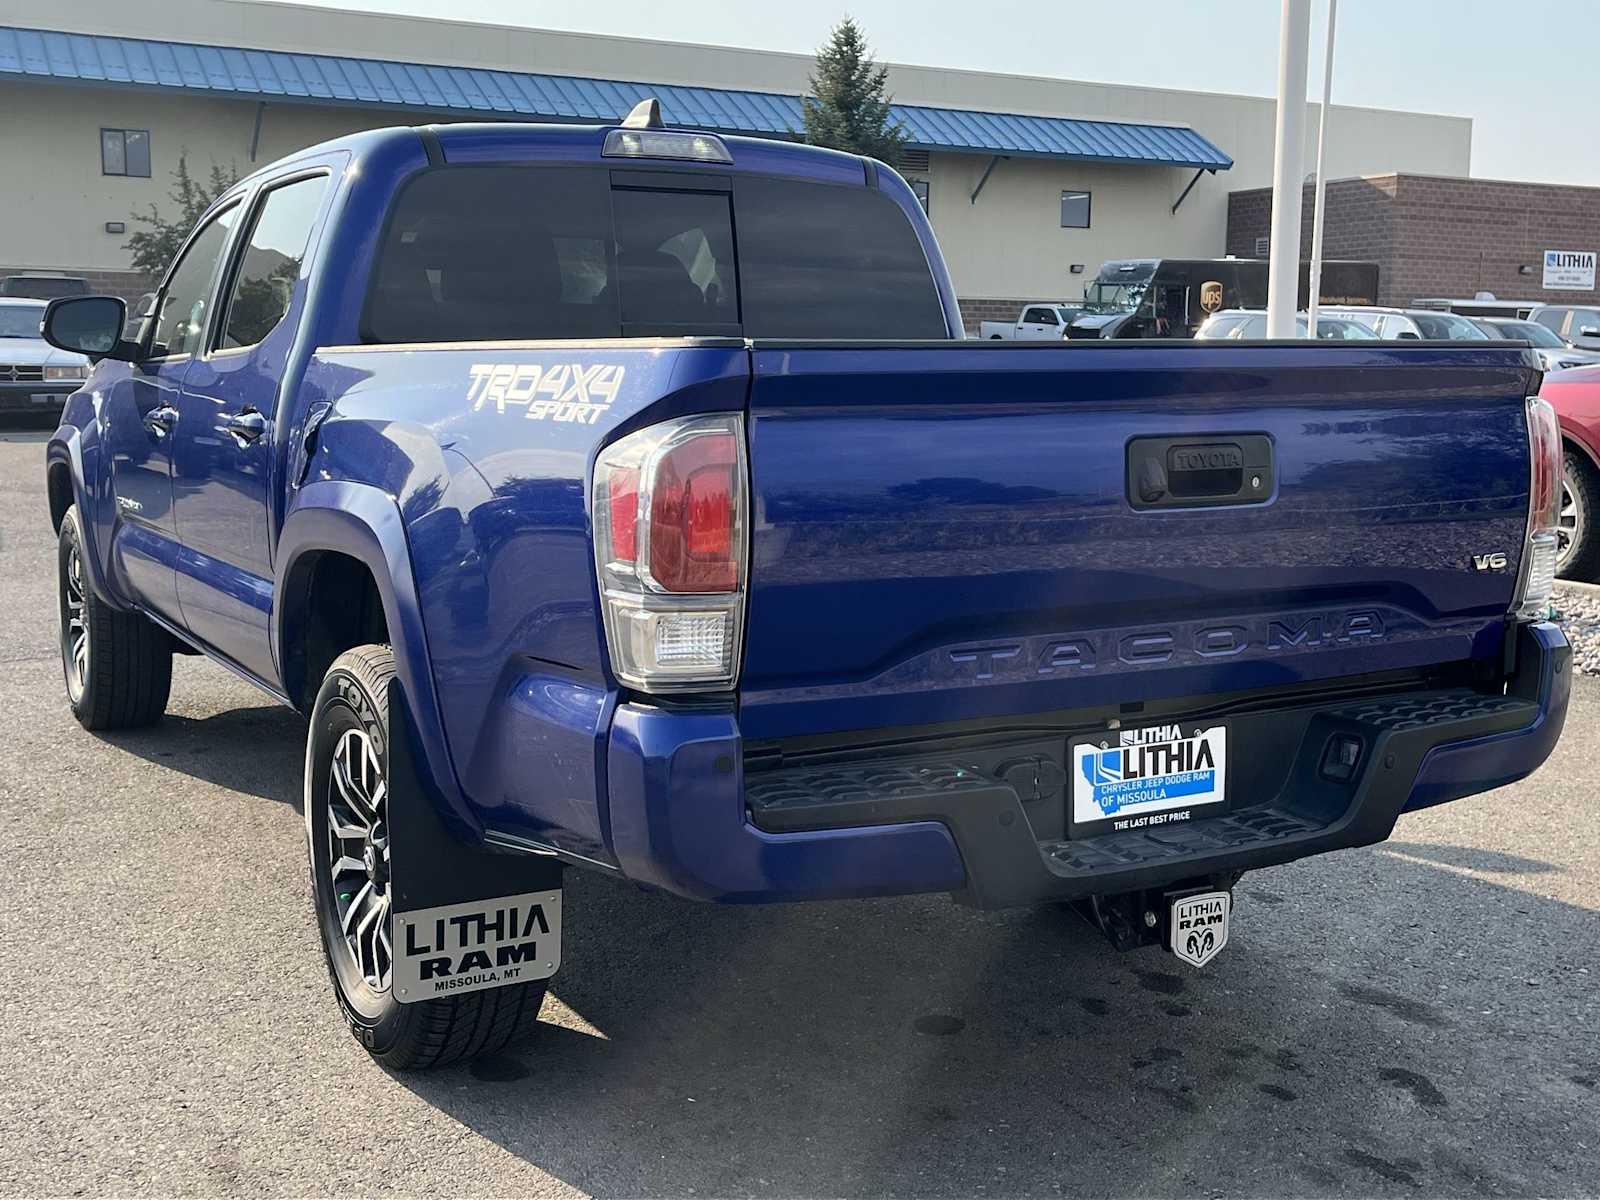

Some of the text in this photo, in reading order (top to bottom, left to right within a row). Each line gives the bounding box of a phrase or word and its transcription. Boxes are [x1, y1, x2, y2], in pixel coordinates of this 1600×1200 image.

[1557, 254, 1593, 268] LITHIA
[524, 400, 610, 425] SPORT
[1177, 451, 1241, 469] TOYOTA
[1473, 552, 1507, 570] V6
[949, 608, 1387, 680] TACOMA
[1133, 724, 1182, 744] LITHIA
[1123, 739, 1215, 780] LITHIA
[1101, 771, 1210, 794] CHRYSLER JEEP DODGE RAM
[1102, 789, 1167, 808] OF MISSOULA
[1114, 811, 1191, 831] THE LAST BEST PRICE
[1181, 901, 1222, 919] LITHIA
[406, 904, 550, 957] LITHIA
[1180, 914, 1223, 930] RAM
[420, 941, 536, 980] RAM
[434, 967, 521, 992] MISSOULA, MT
